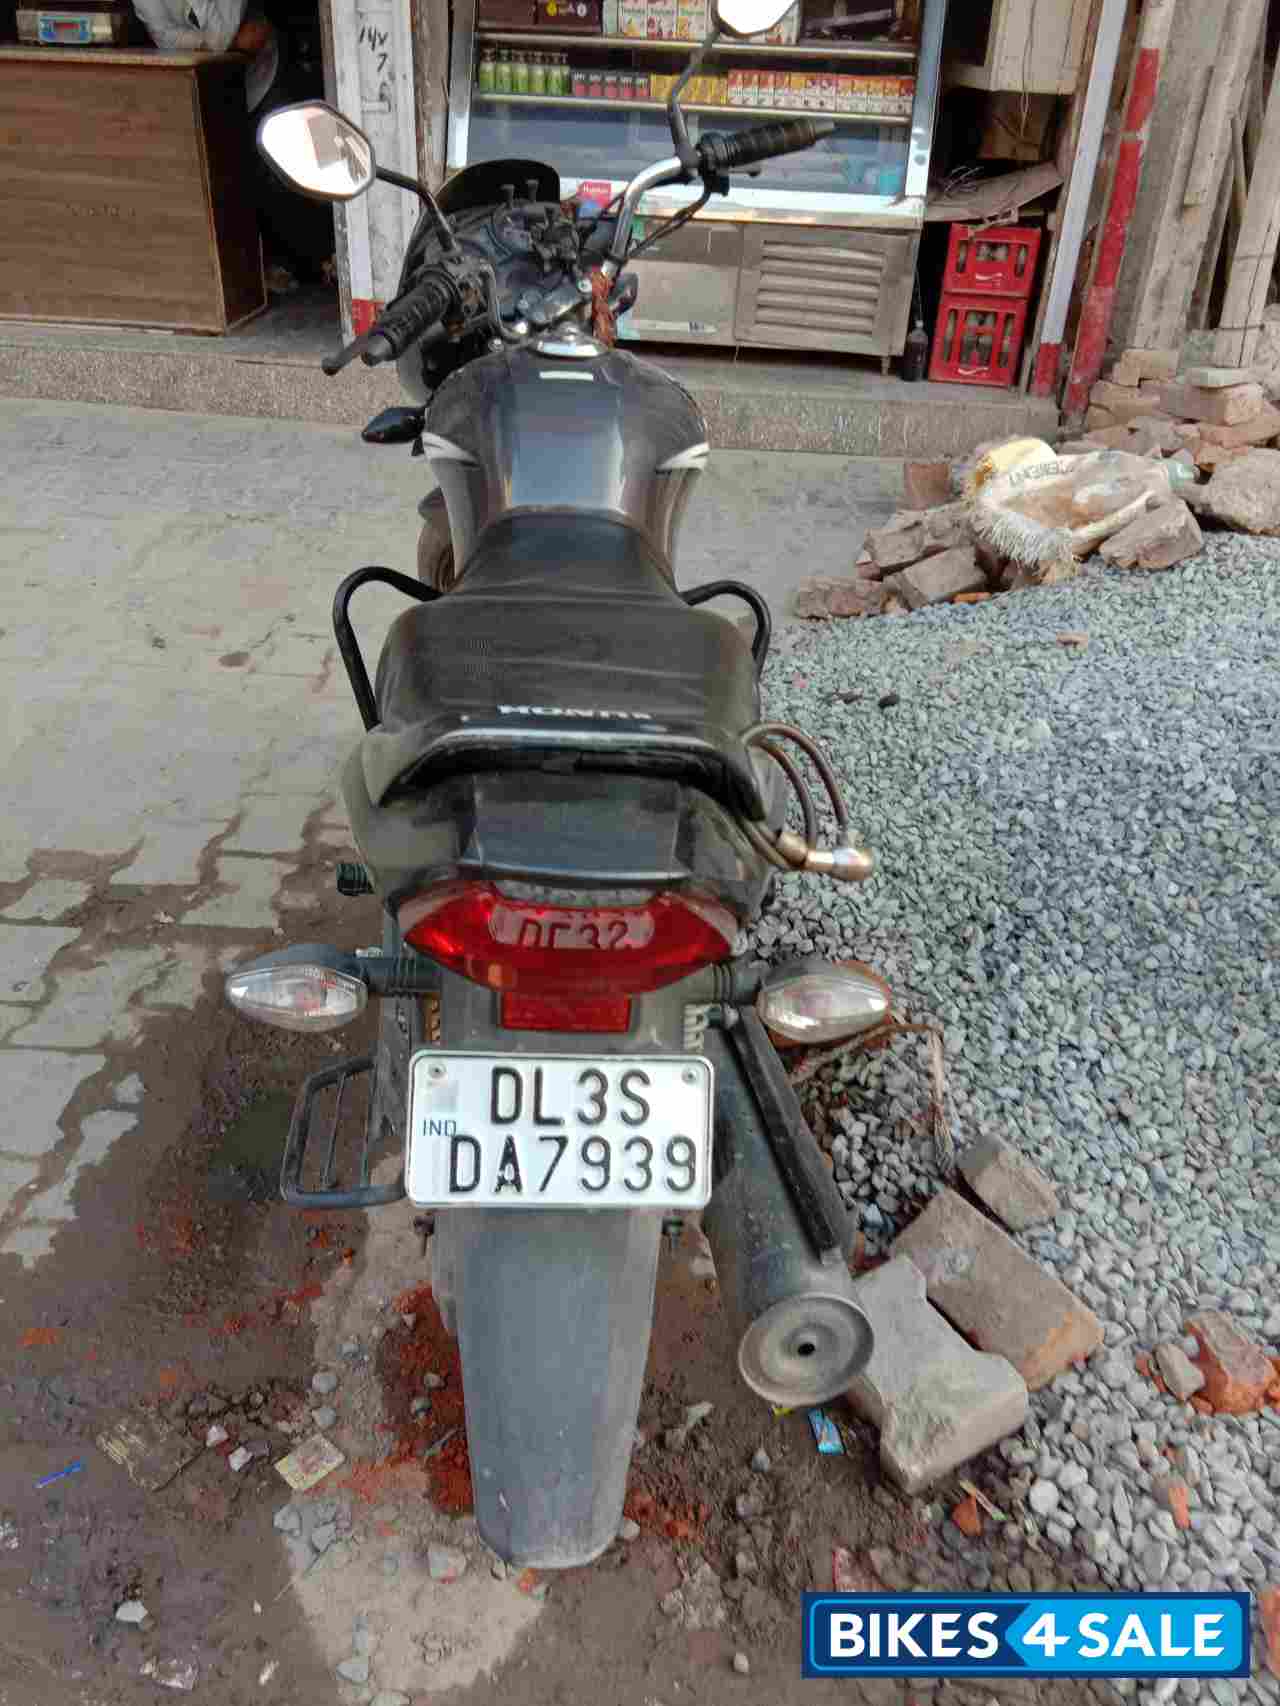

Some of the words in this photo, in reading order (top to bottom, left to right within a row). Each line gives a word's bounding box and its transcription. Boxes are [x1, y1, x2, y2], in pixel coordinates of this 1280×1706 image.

[490, 1066, 650, 1127] DL3S
[422, 1120, 457, 1137] IND
[450, 1135, 697, 1193] DA7939
